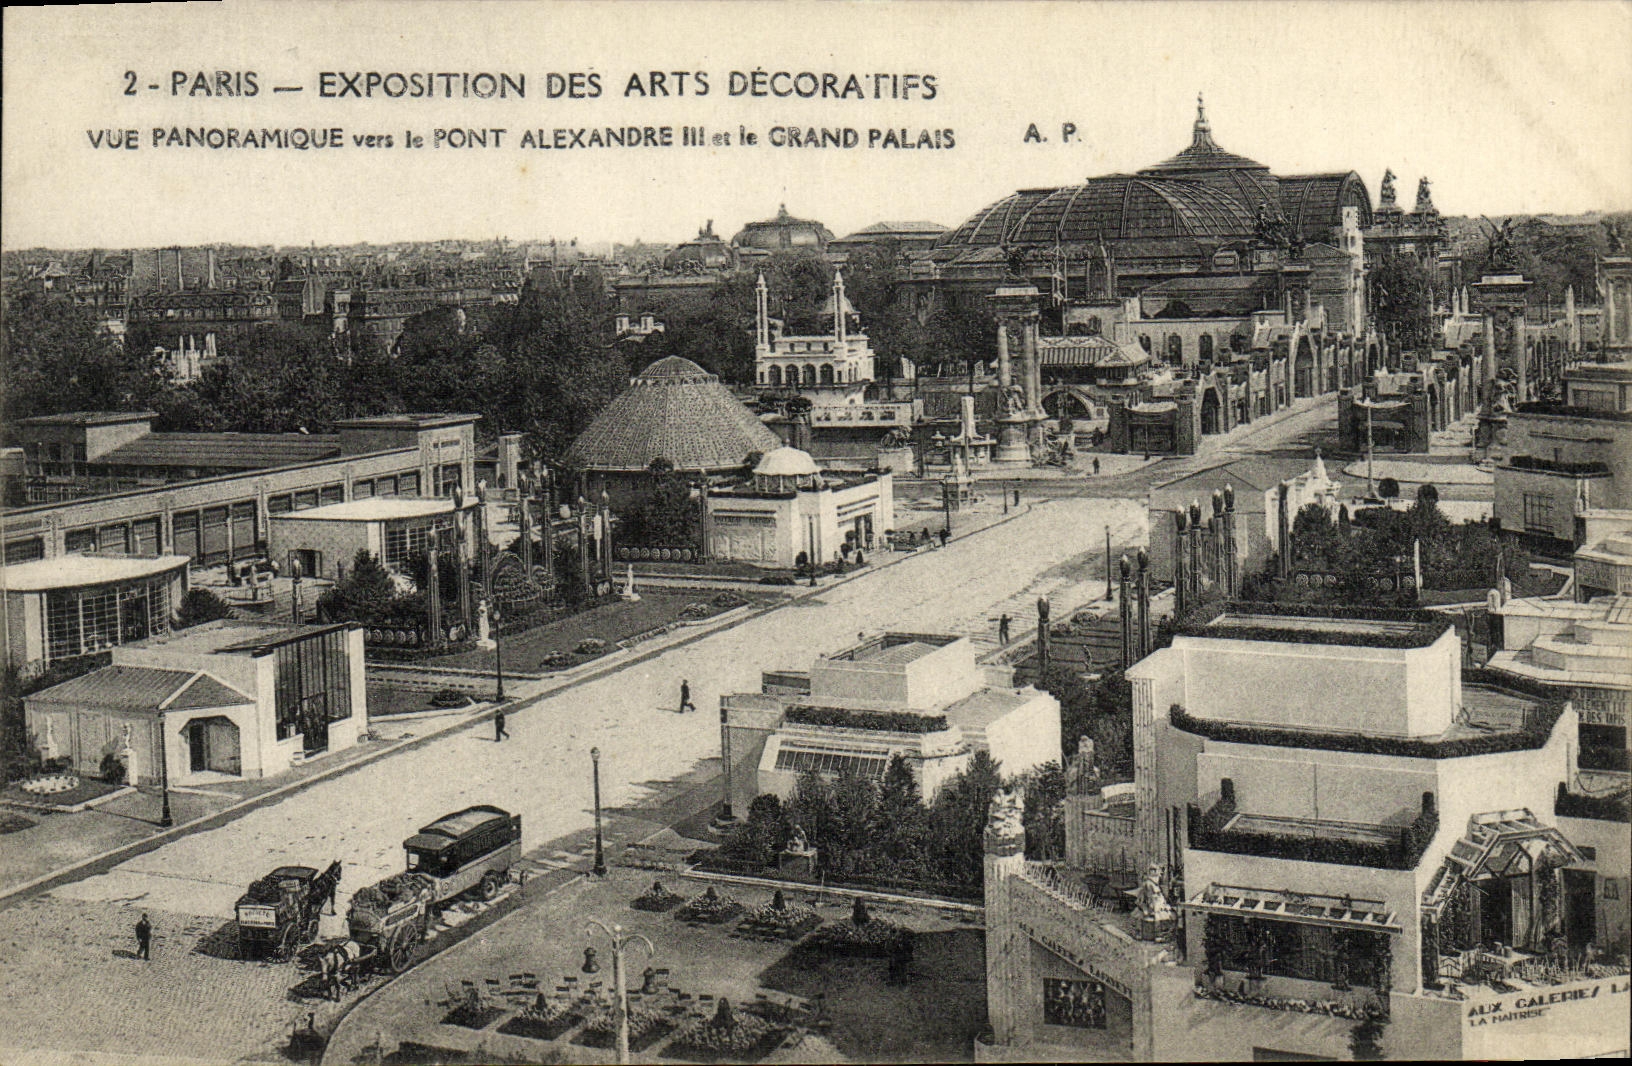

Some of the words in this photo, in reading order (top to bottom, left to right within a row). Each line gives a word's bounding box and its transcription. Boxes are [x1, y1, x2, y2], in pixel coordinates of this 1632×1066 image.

[1467, 1002, 1502, 1017] AUX
[1515, 985, 1600, 1009] GALERIES
[1469, 1018, 1487, 1027] LA
